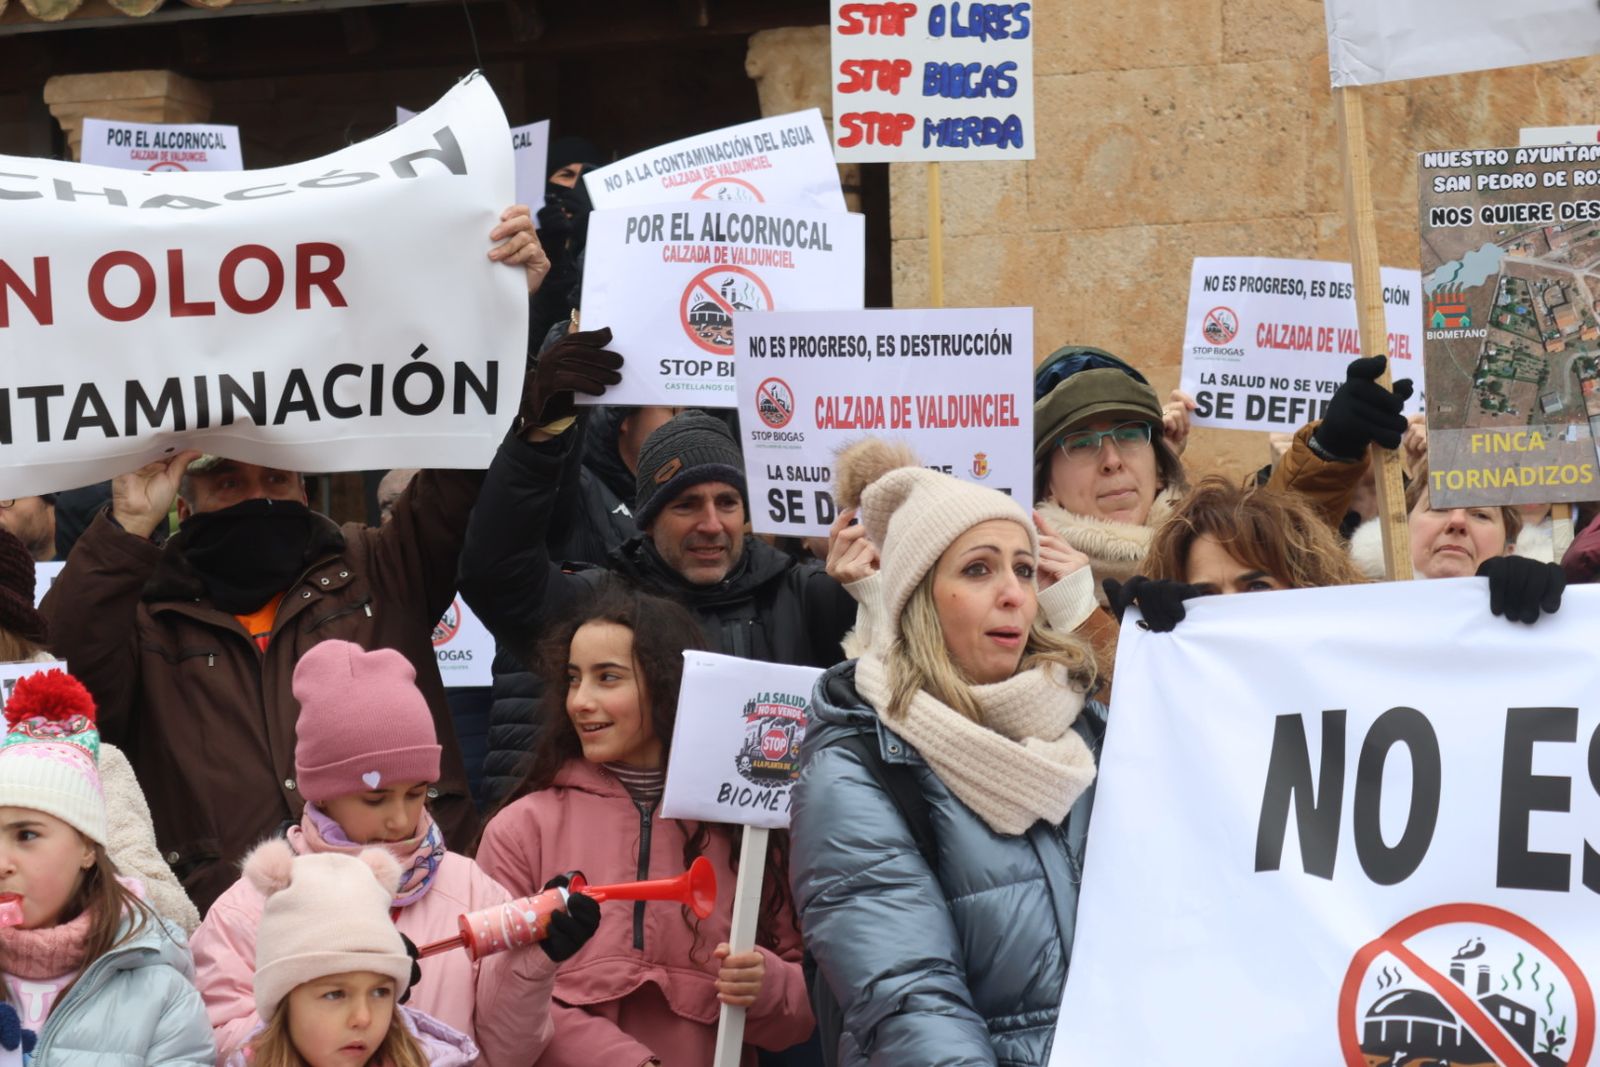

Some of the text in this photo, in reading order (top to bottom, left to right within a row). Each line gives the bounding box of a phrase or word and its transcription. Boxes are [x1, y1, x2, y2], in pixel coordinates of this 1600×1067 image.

[837, 2, 918, 37] STOP
[837, 59, 1018, 99] STOP BIOGAS
[107, 128, 227, 150] POR EL ALCORNOCAL
[837, 111, 916, 148] STOP
[130, 149, 208, 162] CALZADA DE VALDUNCIEL
[604, 125, 815, 192] NO A LA CONTAMINACIÓN DEL AGUA
[1423, 150, 1509, 168] NUESTRO
[661, 155, 773, 189] CALZADA DE VALDUNCIEL
[1433, 169, 1600, 193] SAN PEDRO DE RO
[1430, 207, 1474, 227] NOS
[1480, 202, 1554, 225] QUIERE
[625, 212, 833, 252] POR EL ALCORNOCAL
[662, 245, 796, 269] CALZADA DE VALDUNCIEL
[87, 242, 348, 323] OLOR
[1203, 275, 1220, 293] NO
[1222, 275, 1236, 293] ES
[1239, 276, 1307, 300] PROGRESO,
[1310, 280, 1326, 298] ES
[749, 328, 1013, 362] NO ES PROGRESO, ES DESTRUCCIÓN
[1256, 322, 1313, 352] CALZADA
[1316, 326, 1334, 353] DE
[1426, 328, 1488, 340] BIOMETANO
[1193, 346, 1245, 357] STOP BIOGAS
[659, 358, 713, 377] STOP
[664, 382, 722, 392] CASTELLANOS
[1200, 372, 1217, 386] LA
[1220, 373, 1266, 389] SALUD
[1269, 376, 1290, 391] NO
[1293, 378, 1311, 392] SE
[815, 393, 1020, 430] CALZADA DE VALDUNCIEL
[1194, 390, 1235, 420] SE
[751, 431, 805, 442] STOP BIOGAS
[1471, 431, 1546, 453] FINCA
[767, 464, 831, 483] LA SALUD
[1430, 463, 1594, 491] TORNADIZOS
[767, 487, 806, 524] SE
[757, 692, 807, 708] LA SALUD
[758, 705, 770, 715] NO
[777, 706, 802, 719] VENDE
[763, 736, 787, 751] STOP
[1254, 705, 1442, 887] NO
